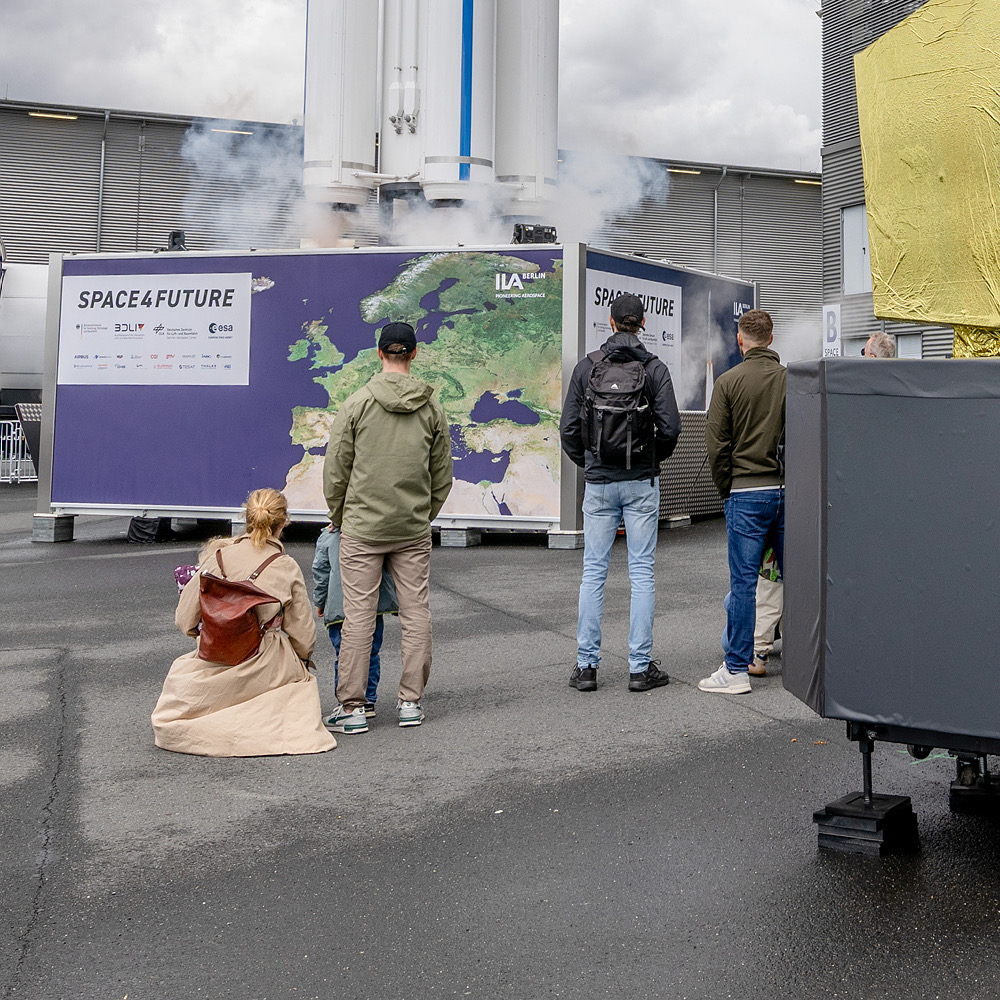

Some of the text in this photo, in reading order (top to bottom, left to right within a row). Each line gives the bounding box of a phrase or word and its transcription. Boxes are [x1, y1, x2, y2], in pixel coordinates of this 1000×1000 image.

[496, 273, 524, 290] ILA
[78, 289, 235, 309] SPACE4FUTURE
[733, 301, 744, 316] ILA
[218, 324, 233, 332] esa
[827, 311, 837, 342] B
[825, 347, 839, 357] SPACE
